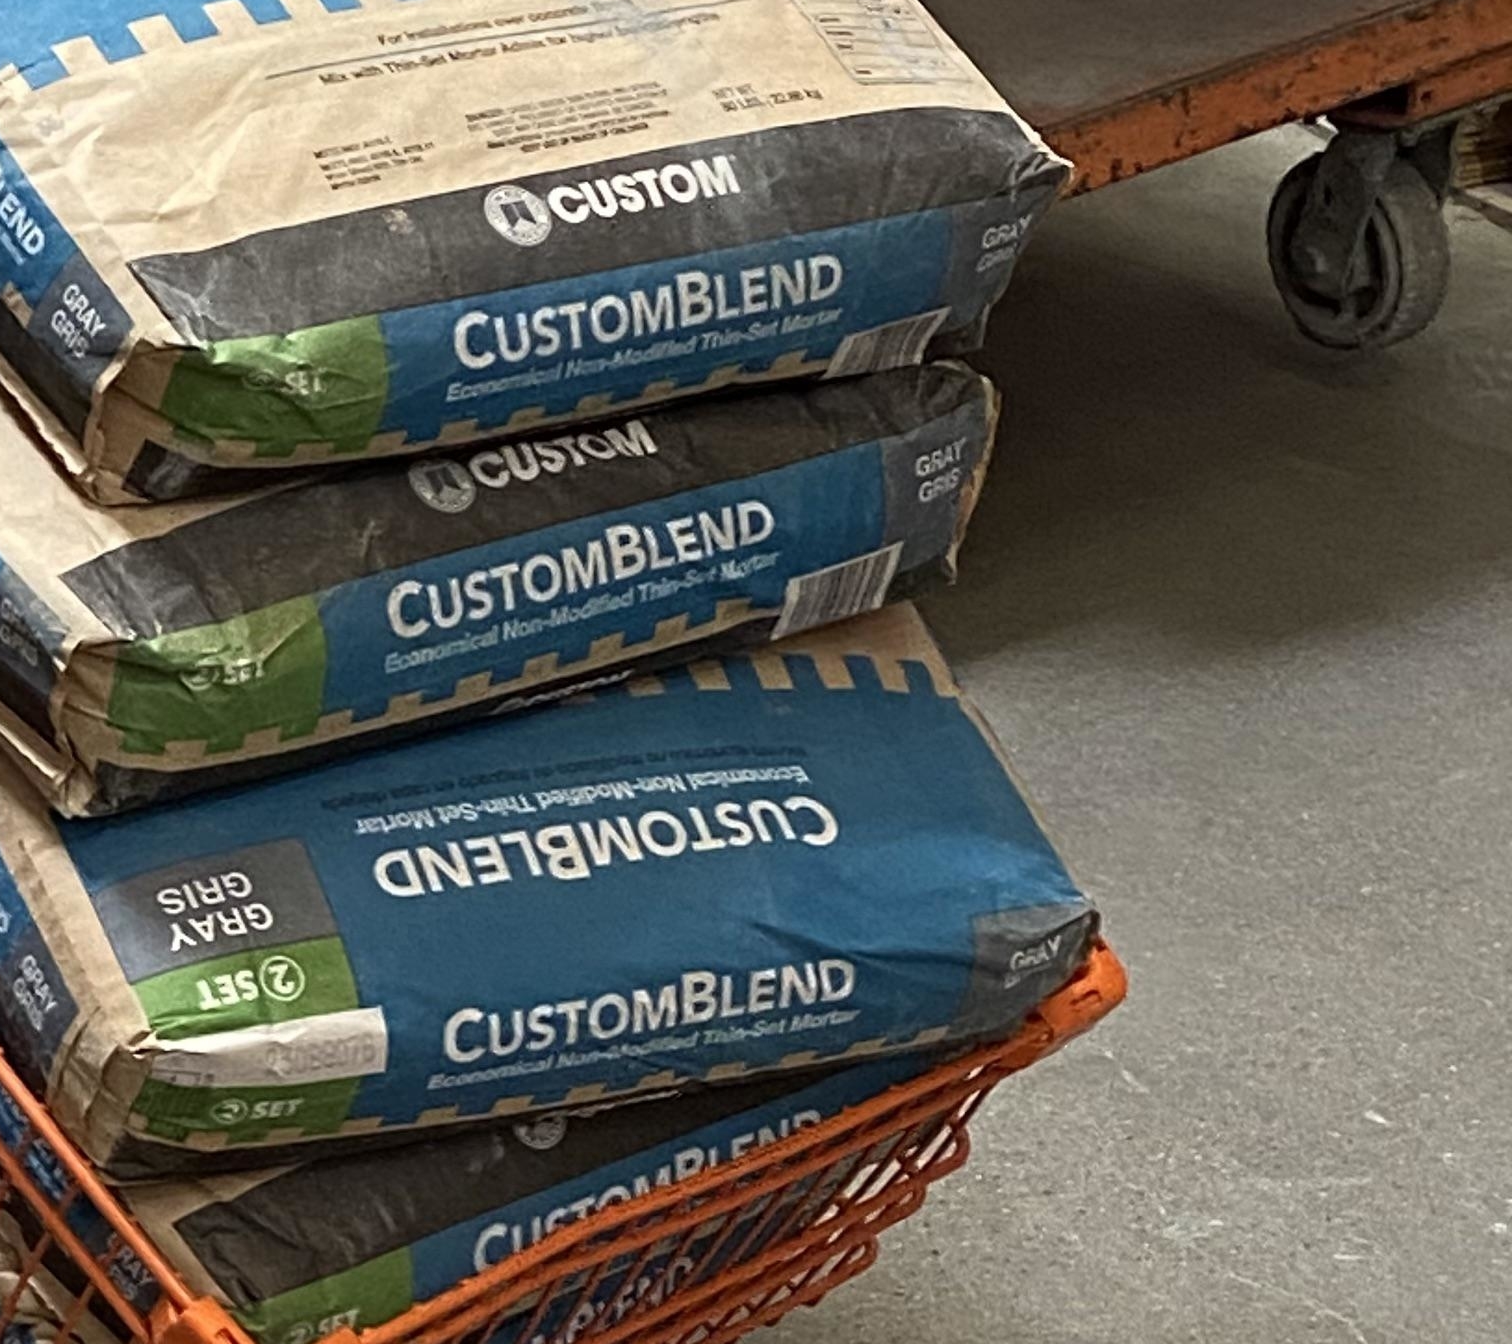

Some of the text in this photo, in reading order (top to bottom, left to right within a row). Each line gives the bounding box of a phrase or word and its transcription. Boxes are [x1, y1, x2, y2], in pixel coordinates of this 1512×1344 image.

[547, 155, 741, 224] CUSTOM
[50, 309, 89, 359] GRIS
[62, 283, 107, 339] GRAY
[453, 254, 843, 371] CUSTOMBLEND
[445, 364, 563, 403] Economical
[468, 419, 659, 489] CUSTOM
[914, 436, 968, 478] GRAY
[917, 468, 963, 505] GRIS
[387, 500, 776, 640] CUSTOMBLEND
[384, 624, 499, 674] Economical
[502, 590, 634, 642] Non-Modified
[539, 772, 687, 811] Non-Modified
[687, 764, 813, 790] Economical
[354, 802, 439, 836] Mortar
[442, 789, 537, 826] Thin-Set
[372, 795, 839, 898] CUSTOMBLEND
[156, 871, 254, 915] GRIS
[170, 903, 275, 952] GRAY
[21, 955, 58, 1012] GRAY
[195, 969, 260, 1011] SET
[444, 958, 856, 1065] CUSTOMBLEND
[426, 1054, 553, 1091] Economical
[702, 1018, 787, 1047] Thin-Set
[789, 1009, 862, 1033] Mortar
[250, 1098, 304, 1120] SET
